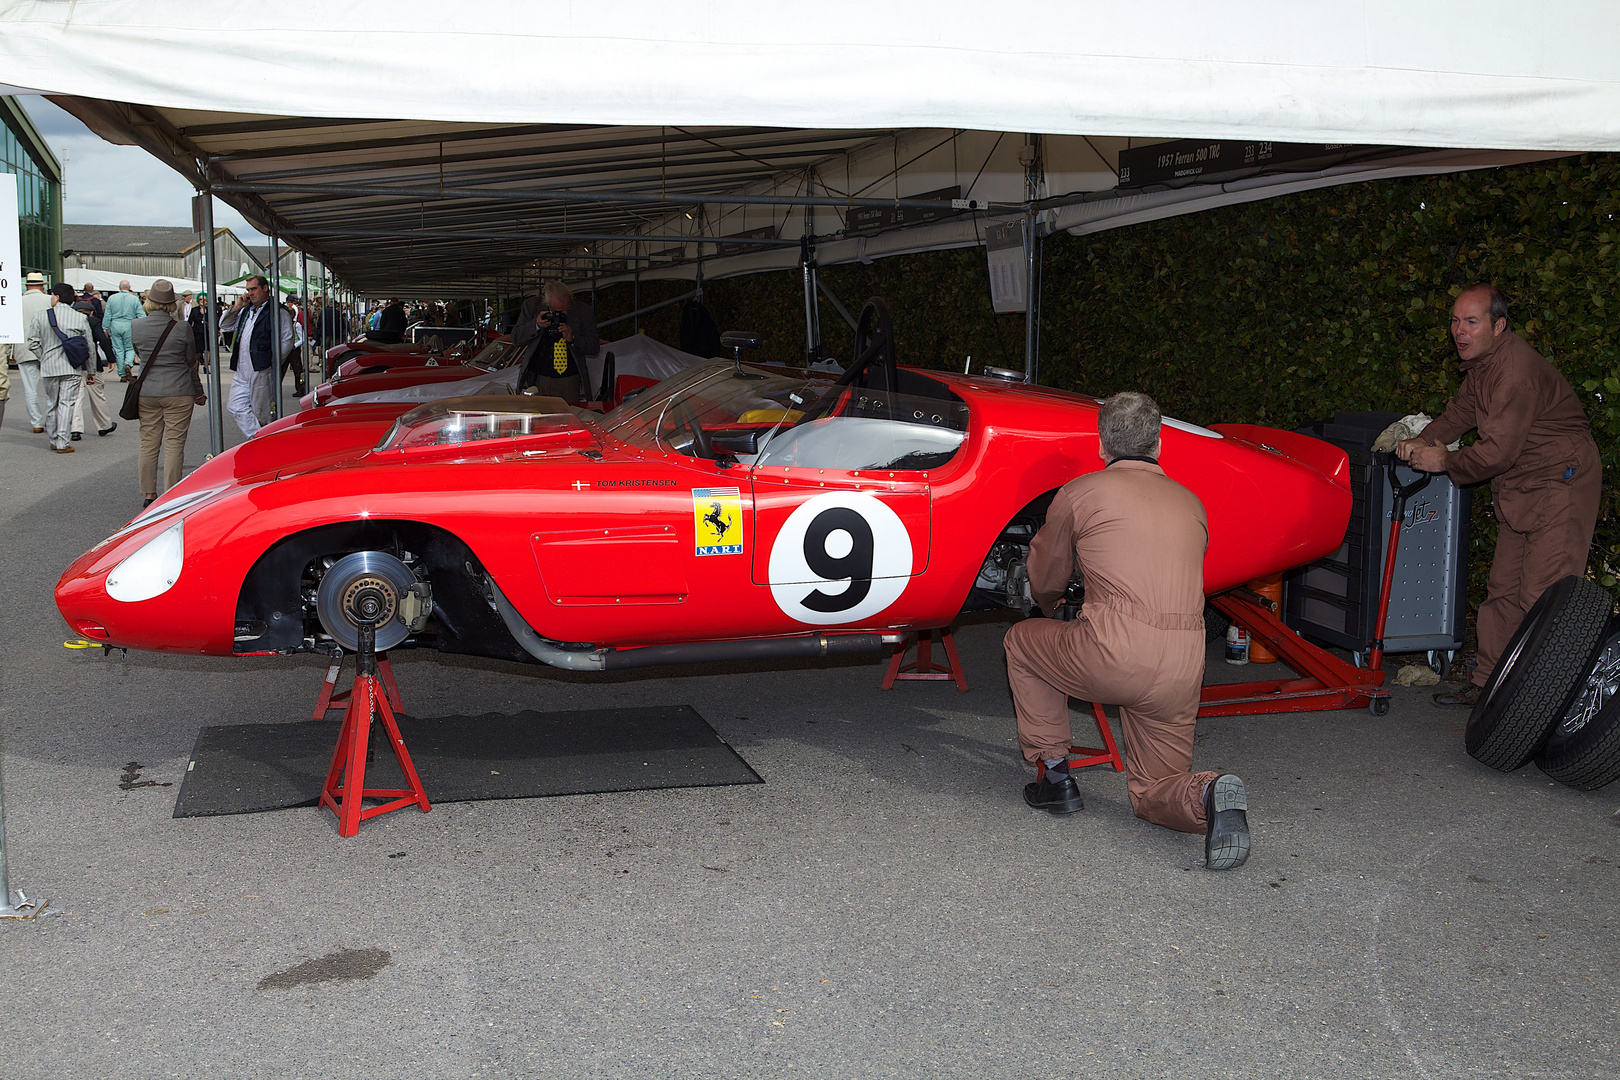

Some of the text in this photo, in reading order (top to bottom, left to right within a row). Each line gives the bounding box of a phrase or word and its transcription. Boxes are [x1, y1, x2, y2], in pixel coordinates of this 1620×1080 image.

[1157, 153, 1174, 168] 1957
[1175, 152, 1195, 166] Ferrari
[1195, 147, 1208, 162] 500
[1244, 141, 1273, 158] 233 234
[1120, 166, 1131, 178] 233
[1427, 510, 1437, 524] 7
[799, 506, 875, 613] 9
